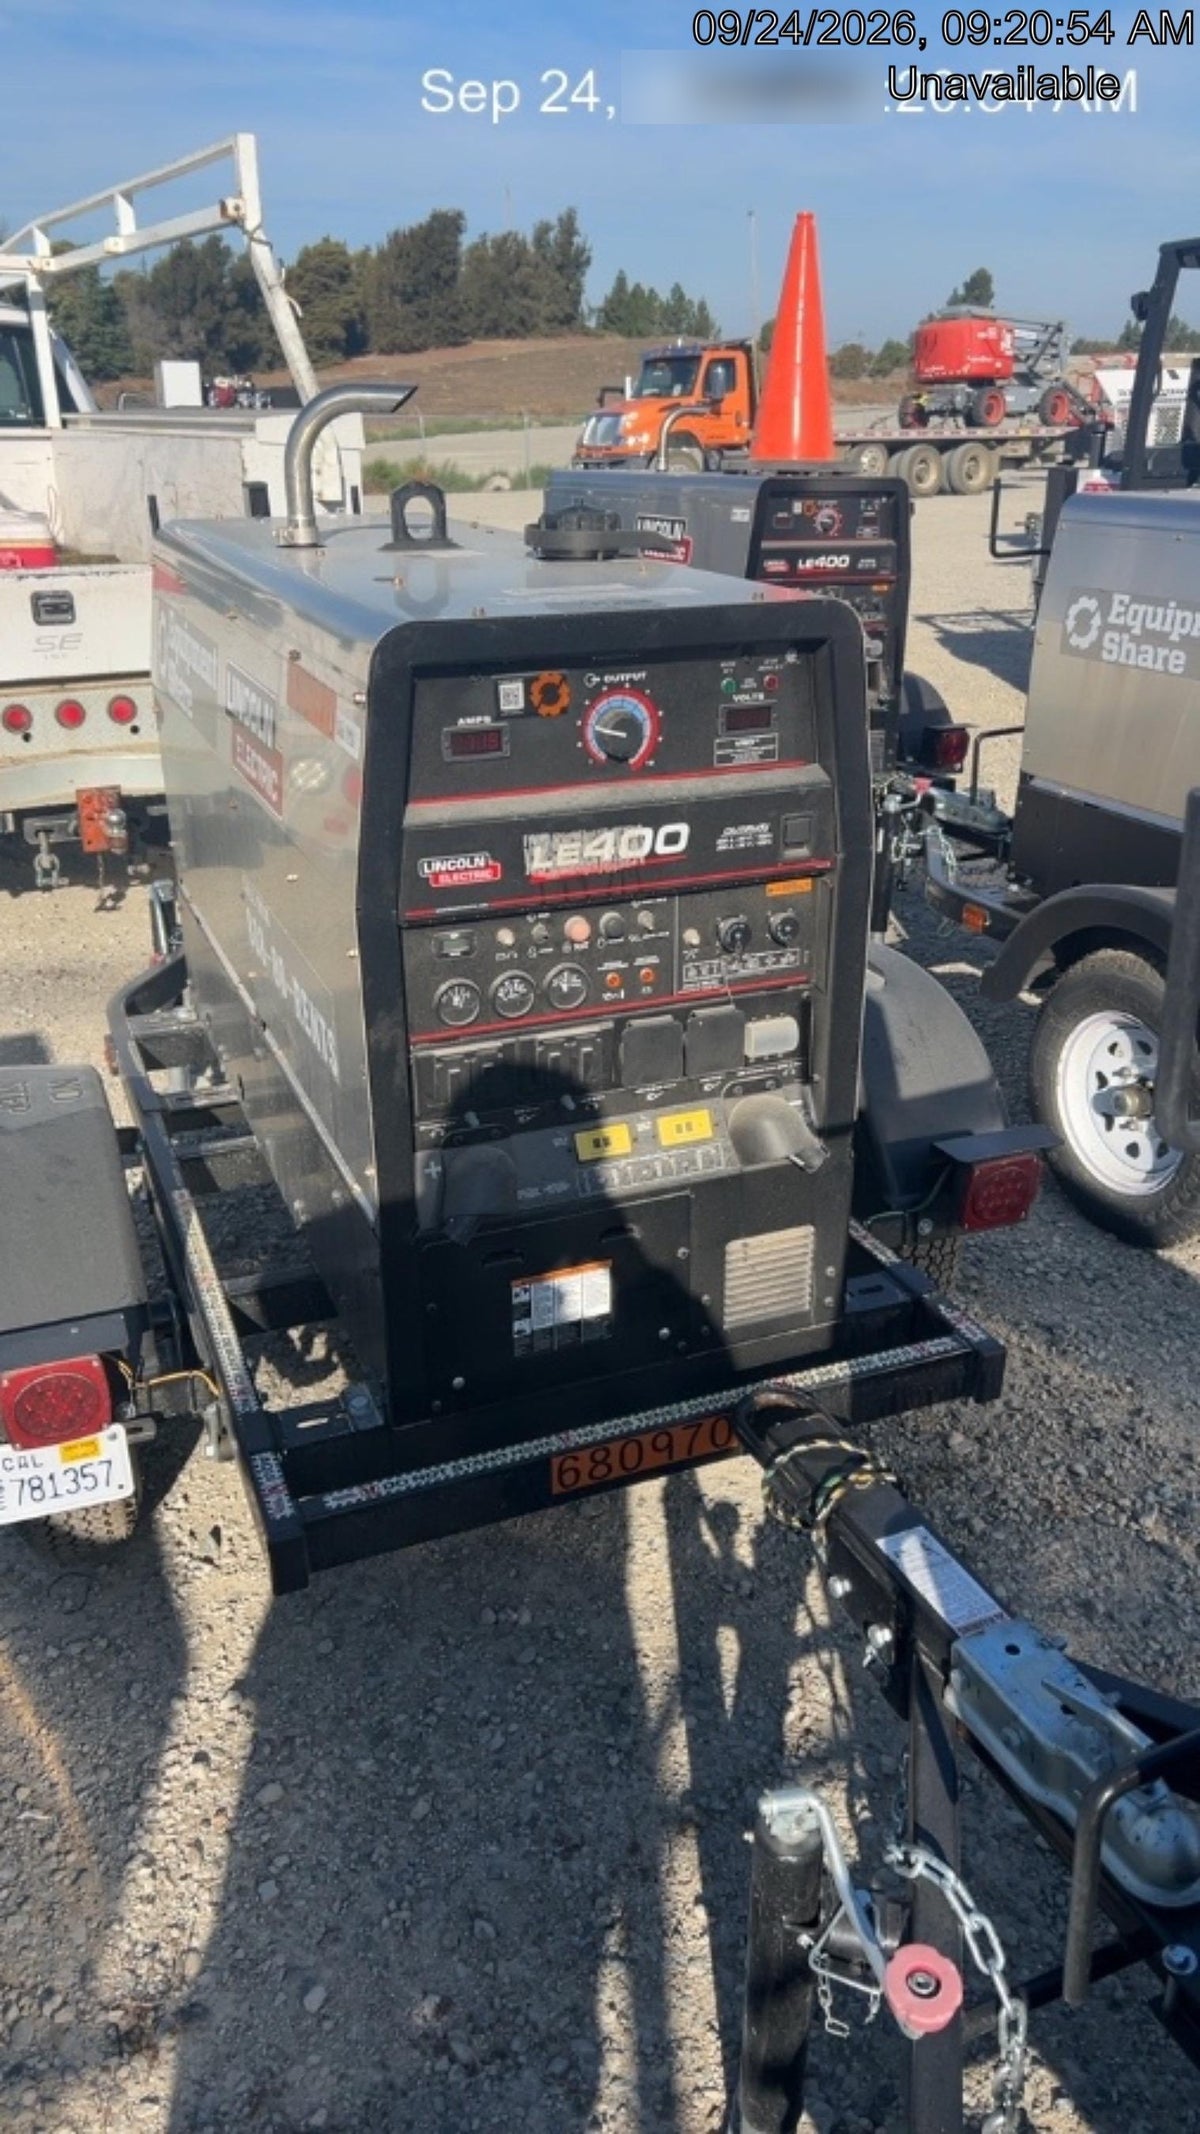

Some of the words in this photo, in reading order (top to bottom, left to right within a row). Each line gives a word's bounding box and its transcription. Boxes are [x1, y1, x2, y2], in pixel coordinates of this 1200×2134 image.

[32, 632, 83, 652] SE
[1102, 630, 1187, 674] Share
[604, 672, 647, 682] OUTPUT
[457, 715, 492, 727] AMPS
[530, 823, 690, 869] LE400
[423, 854, 485, 873] LINCOLN
[438, 869, 495, 885] ELECTRIC
[556, 1417, 733, 1490] 680970
[2, 1455, 44, 1472] CAL
[9, 1459, 113, 1507] 781357
